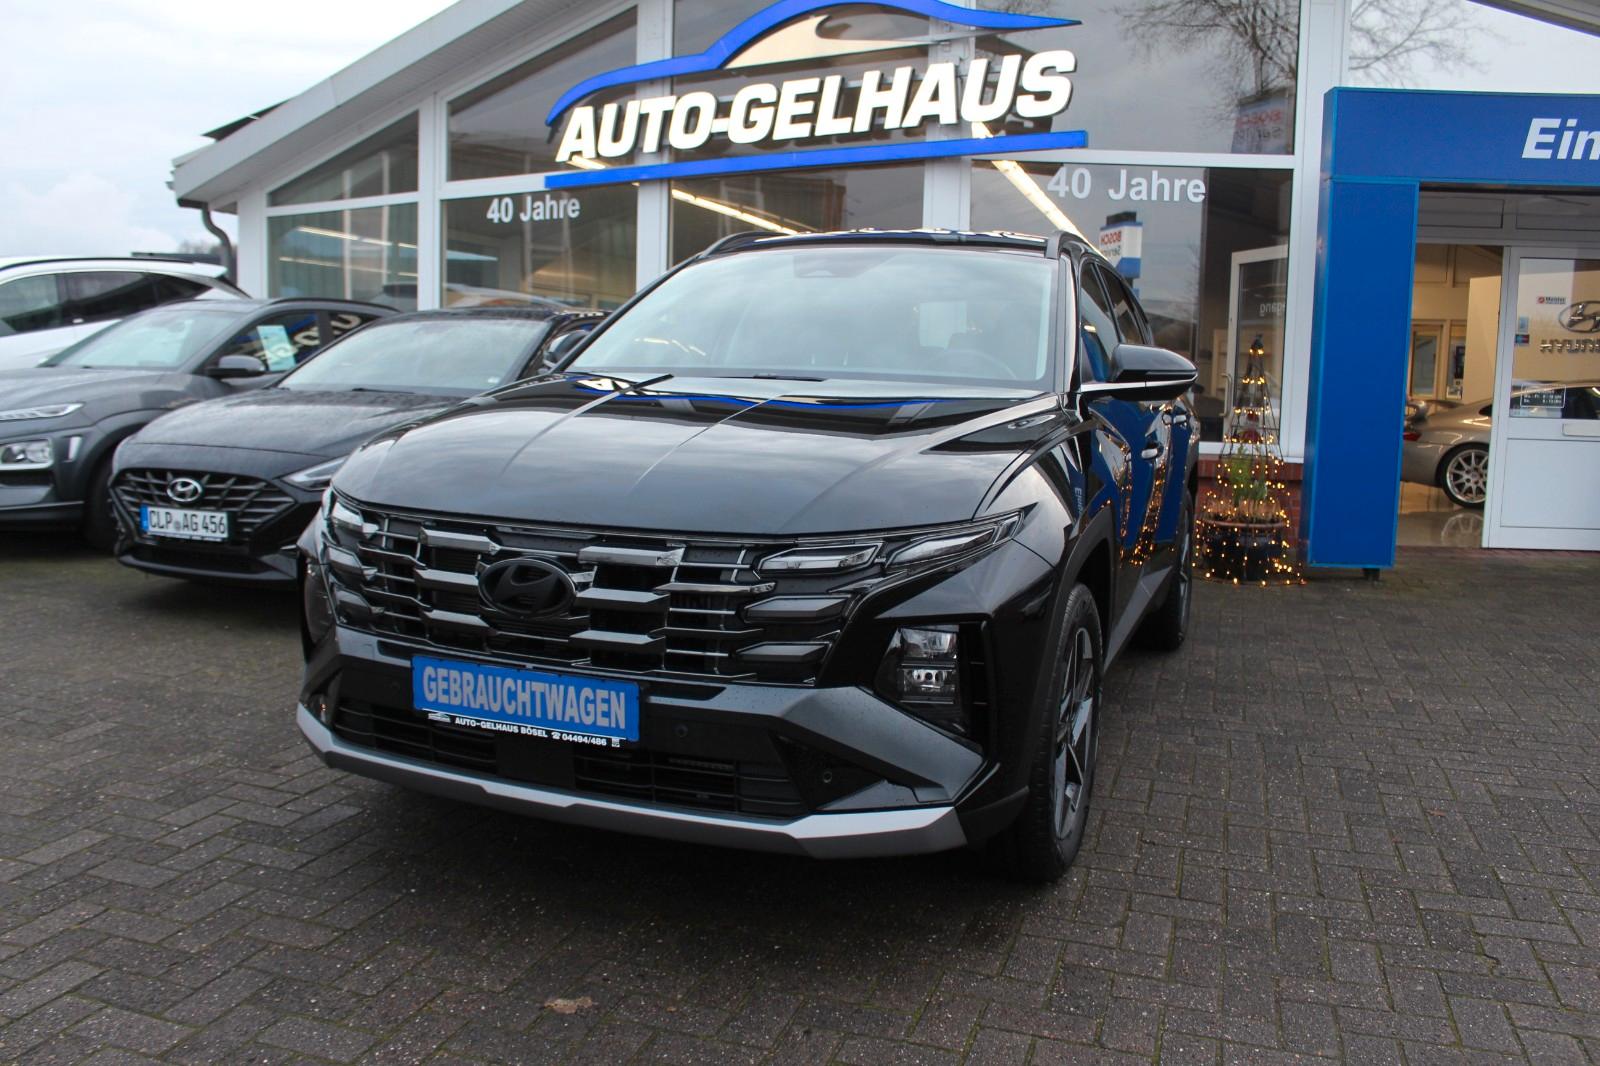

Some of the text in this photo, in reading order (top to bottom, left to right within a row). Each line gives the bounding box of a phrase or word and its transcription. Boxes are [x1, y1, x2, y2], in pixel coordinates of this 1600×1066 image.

[555, 50, 1076, 163] AUTO-GELHAUS
[1522, 118, 1600, 160] Ein
[1047, 167, 1206, 203] 40 Jahre
[486, 194, 580, 223] 40 Jahre
[149, 510, 226, 534] CLP AG 456
[423, 666, 626, 729] GEBRAUCHTWAGEN
[455, 717, 519, 733] AUTO-GELHAUS
[520, 725, 548, 738] BÖSEL
[562, 733, 607, 746] 04494/486
